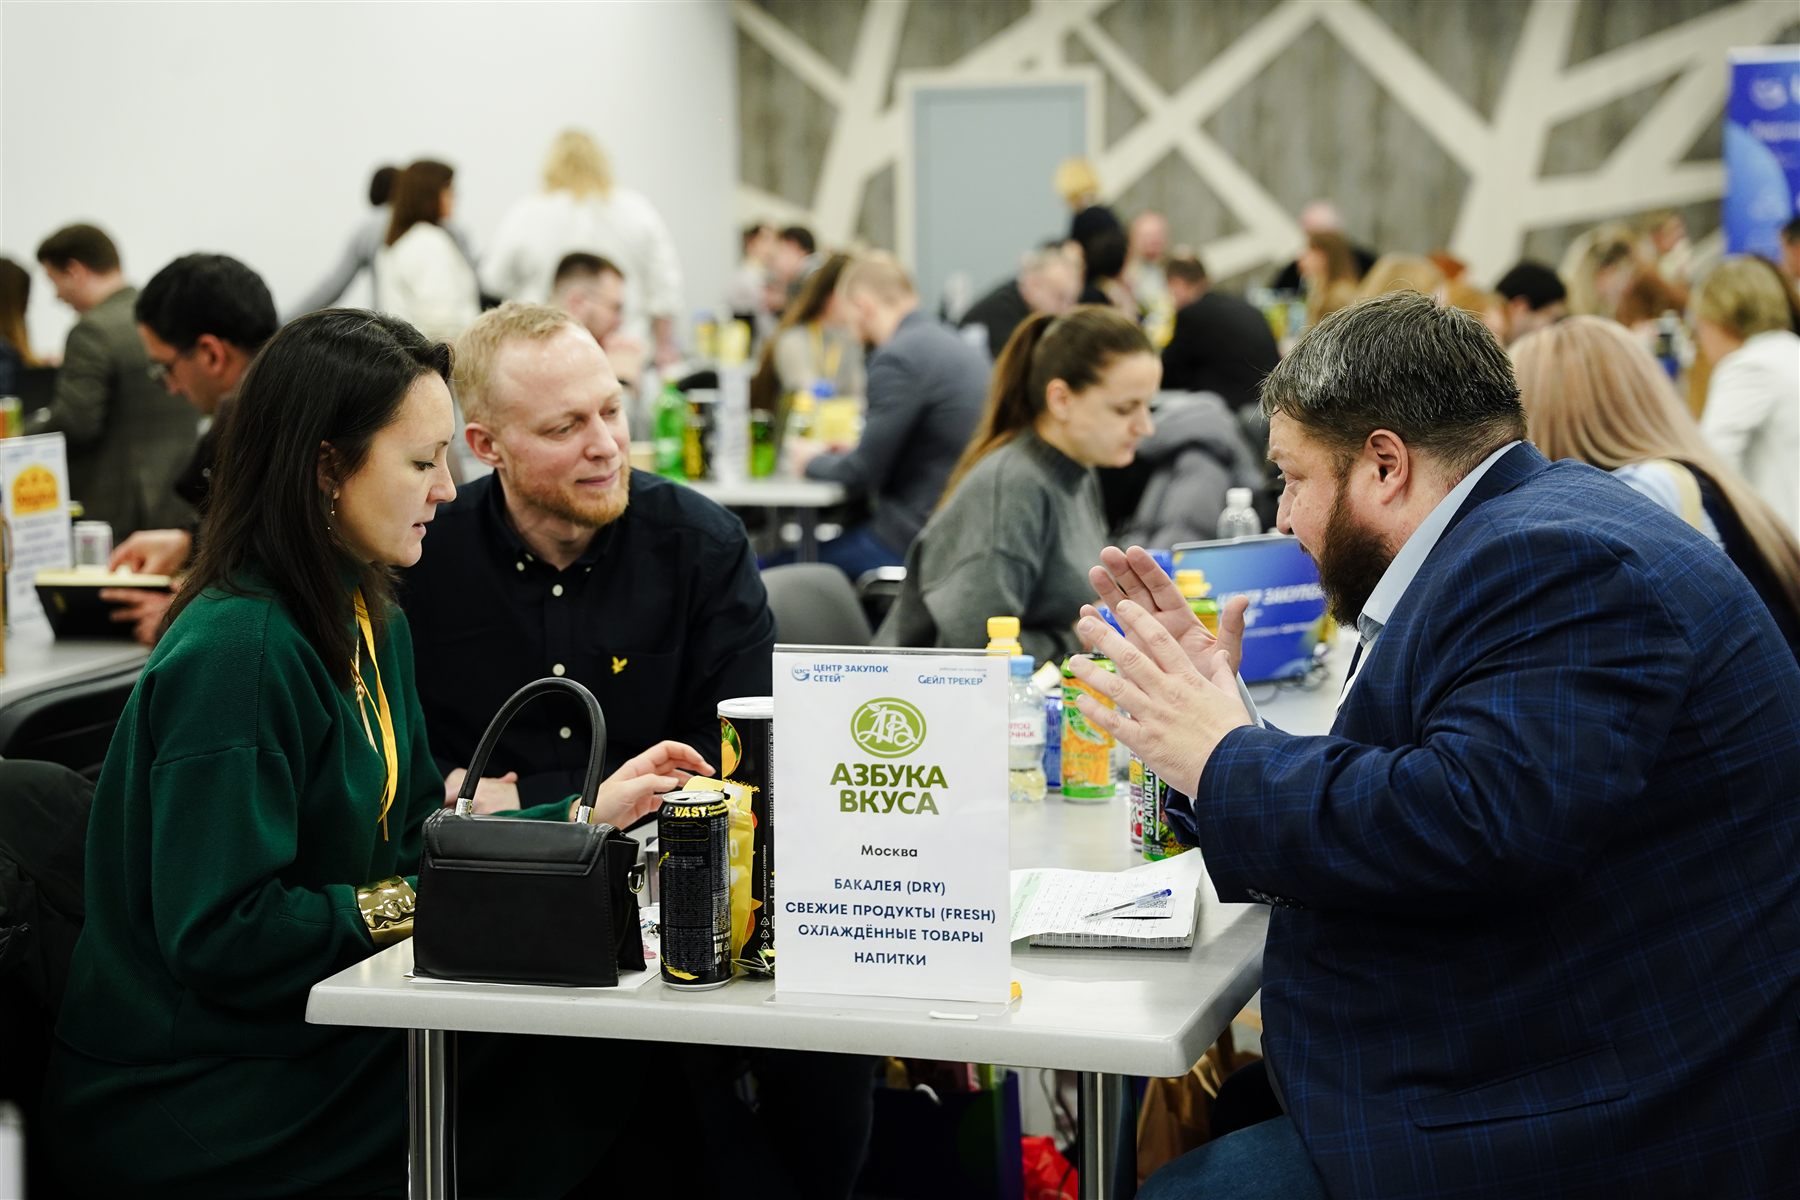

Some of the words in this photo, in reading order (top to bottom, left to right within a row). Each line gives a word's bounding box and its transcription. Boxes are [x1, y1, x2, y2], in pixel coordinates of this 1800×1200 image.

[813, 664, 843, 673] ЦЕНТР
[845, 664, 889, 673] ЗАКУПОК
[830, 763, 949, 789] АЗБУКА
[840, 790, 940, 815] ВКУСА
[674, 806, 707, 818] VAST
[861, 845, 918, 858] Москва
[834, 878, 902, 892] БАКАЛЕЯ
[907, 881, 946, 896] (DRY)
[785, 902, 848, 915] СВЕЖИЕ
[852, 904, 936, 919] ПРОДУКТЫ
[940, 907, 996, 924] (FRESH)
[798, 923, 917, 941] ОХЛАЖДЁННЫЕ
[921, 929, 984, 943] ТОВАРЫ
[854, 952, 927, 966] НАПИТКИ
